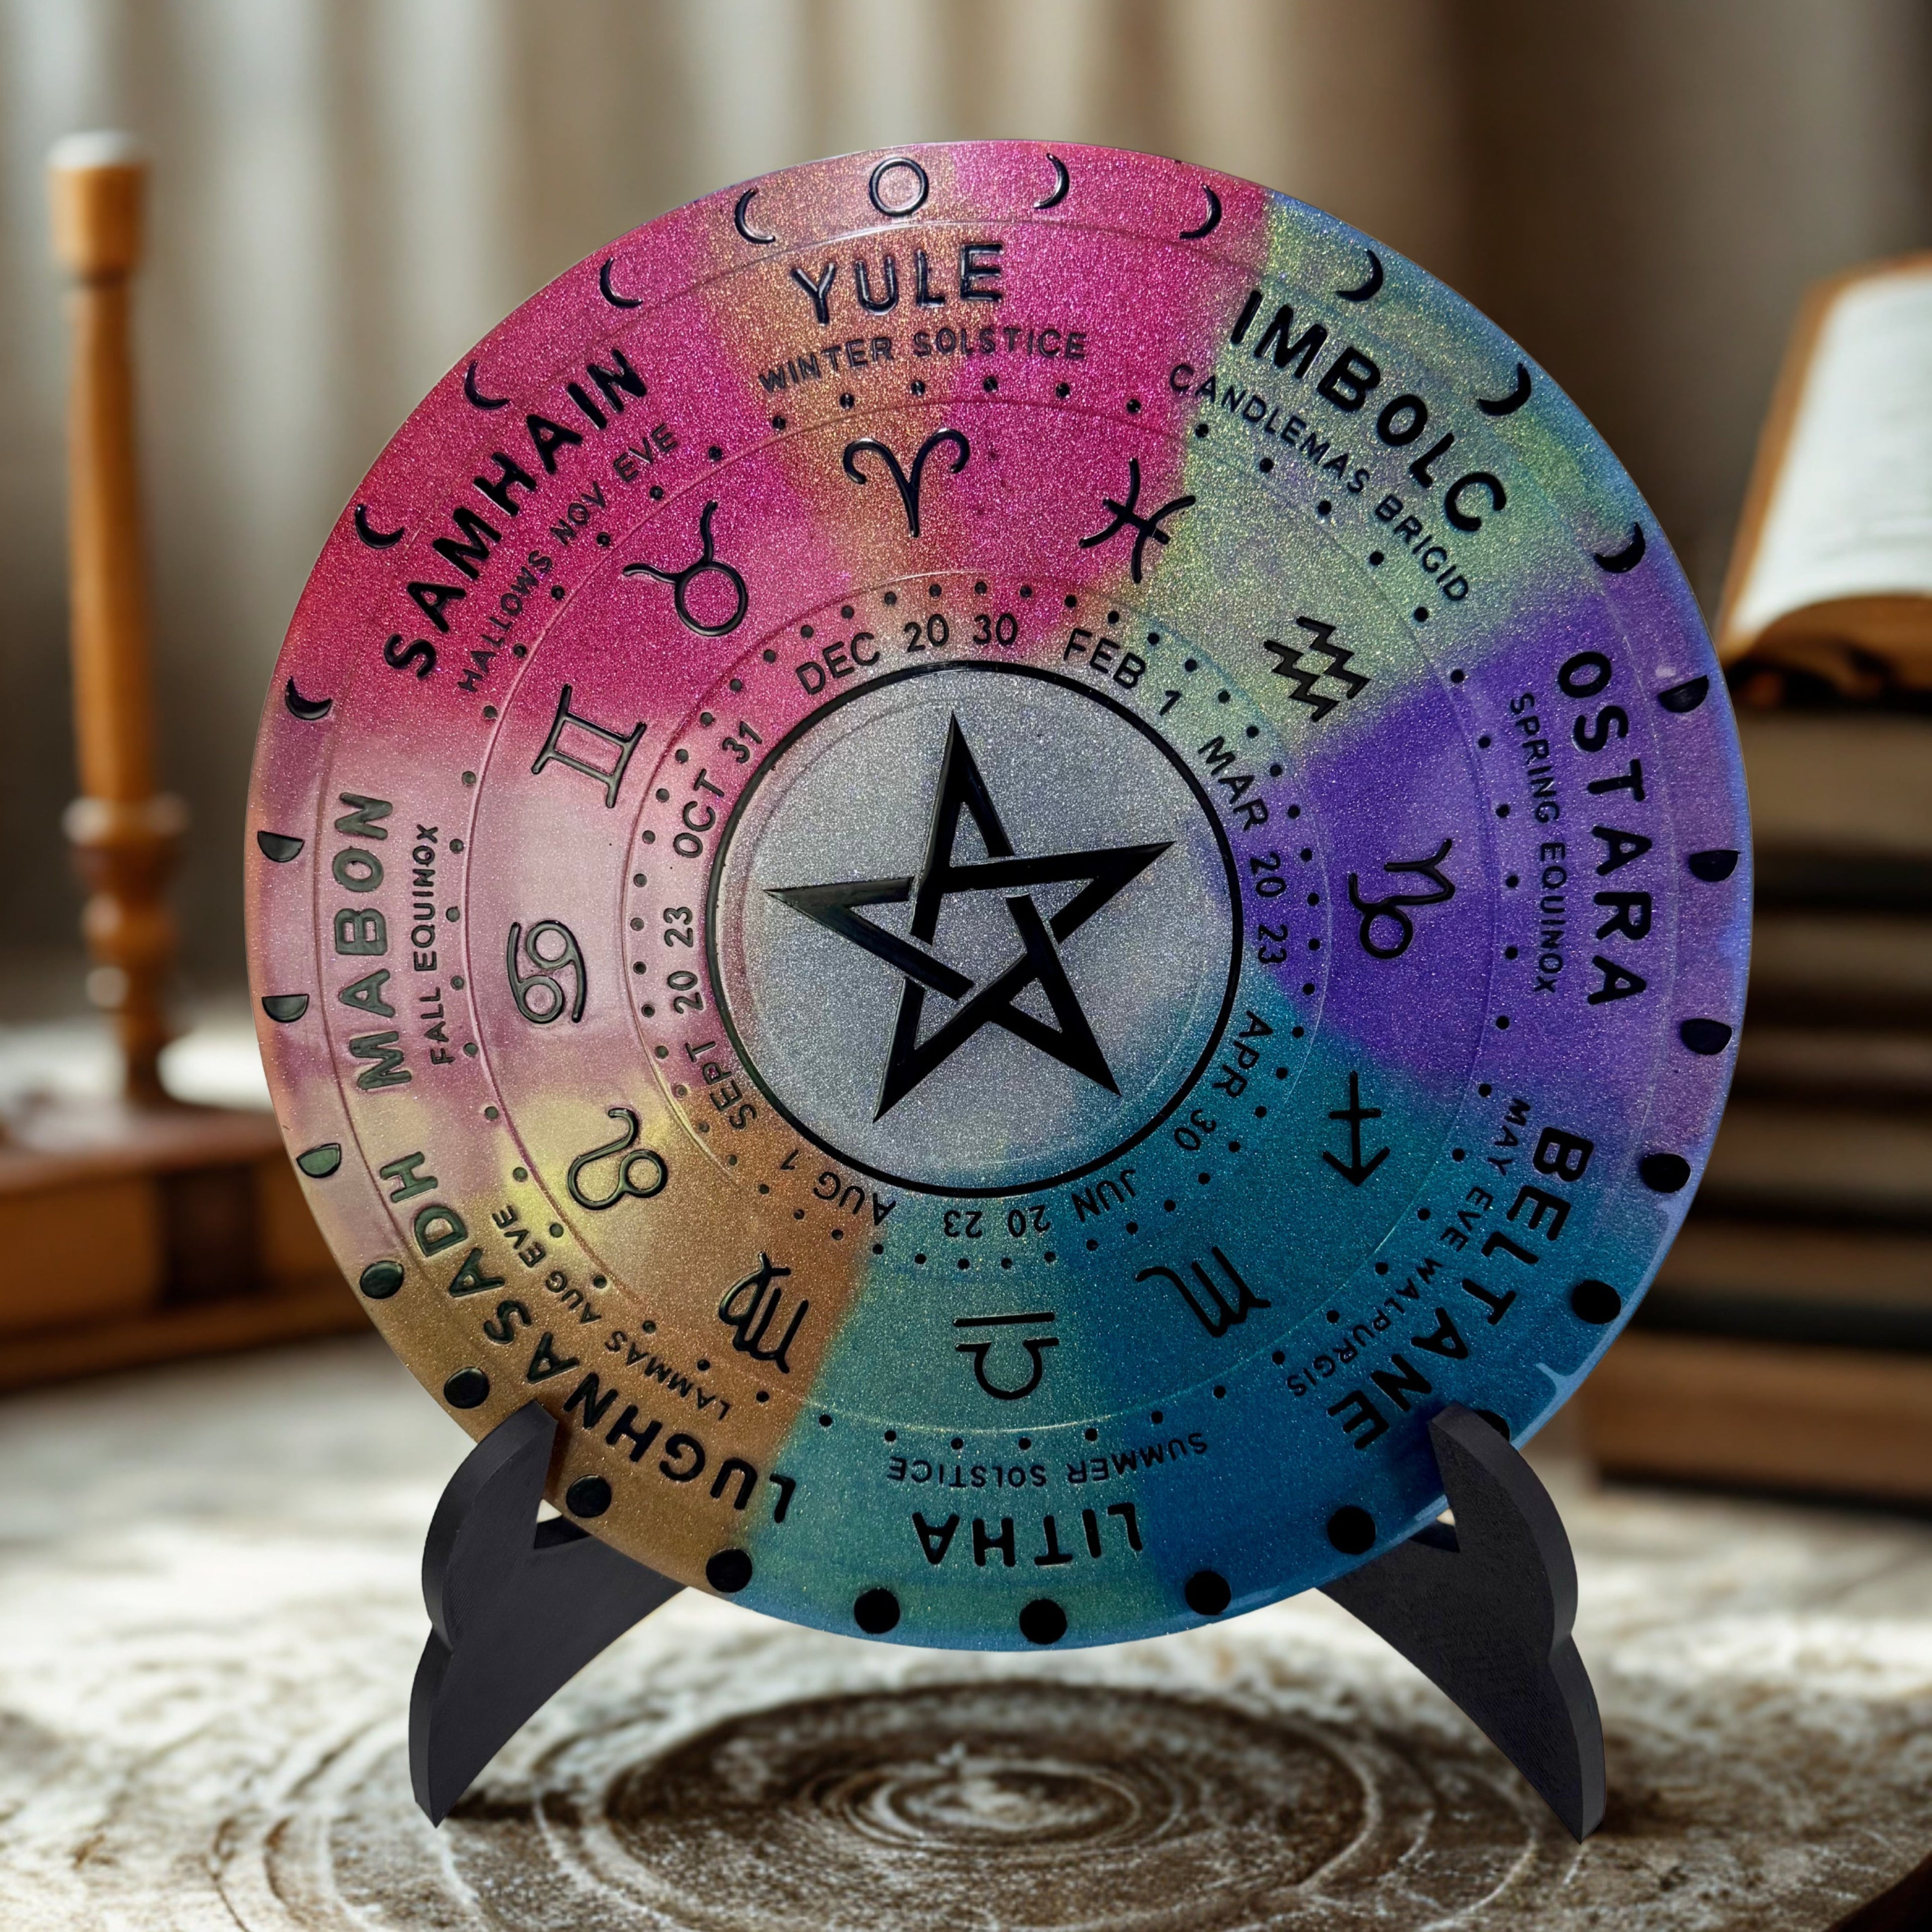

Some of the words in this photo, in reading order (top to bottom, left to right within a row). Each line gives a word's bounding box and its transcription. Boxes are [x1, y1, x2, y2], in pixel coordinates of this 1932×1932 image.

[791, 244, 1003, 325] YULE
[759, 338, 895, 392] WINTER
[913, 328, 1087, 359] SOLSTICE
[1231, 290, 1506, 531] IMBOLC
[384, 349, 647, 680] SAMHAIN
[1170, 364, 1370, 494] CANDLEMAS
[1375, 494, 1469, 601] BRIGID
[457, 550, 552, 692] HALLOWS
[549, 481, 606, 545] NOV
[613, 423, 678, 482] EVE
[795, 632, 880, 695] DEC
[904, 614, 949, 653] 20
[974, 613, 1017, 646] 30
[1064, 628, 1146, 689] FEB
[1159, 690, 1182, 715] 1
[673, 769, 725, 858] OCT
[722, 721, 762, 763] 31
[1198, 736, 1269, 831] MAR
[1510, 693, 1560, 823] SPRING
[1535, 842, 1567, 993] EQUINOX
[1558, 652, 1652, 1005] OSTARA
[412, 824, 439, 972] EQUINOX
[1250, 851, 1287, 898] 20
[333, 792, 412, 1090] MABON
[664, 906, 693, 948] 23
[1258, 924, 1288, 964] 23
[420, 987, 455, 1065] FALL
[668, 971, 704, 1014] 20
[686, 1041, 756, 1130] SEPT
[1212, 1011, 1272, 1097] APR
[781, 1149, 799, 1170] 1
[1174, 1109, 1217, 1151] 30
[1487, 1097, 1531, 1176] MAY
[813, 1171, 897, 1225] AUG
[944, 1210, 982, 1238] 23
[1008, 1204, 1051, 1237] 20
[1072, 1170, 1136, 1222] JUN
[1440, 1187, 1493, 1252] EVE
[492, 1205, 546, 1268] EVE
[545, 1271, 602, 1325] AUG
[1286, 1258, 1443, 1397] WALPURGIS
[1327, 1126, 1594, 1449] BELTANE
[380, 1152, 796, 1523] LUGHNASADH
[605, 1331, 730, 1420] LAMMAS
[887, 1457, 1046, 1487] SOLSTICE
[1068, 1432, 1208, 1484] SUMMER
[912, 1502, 1143, 1567] LITHA
